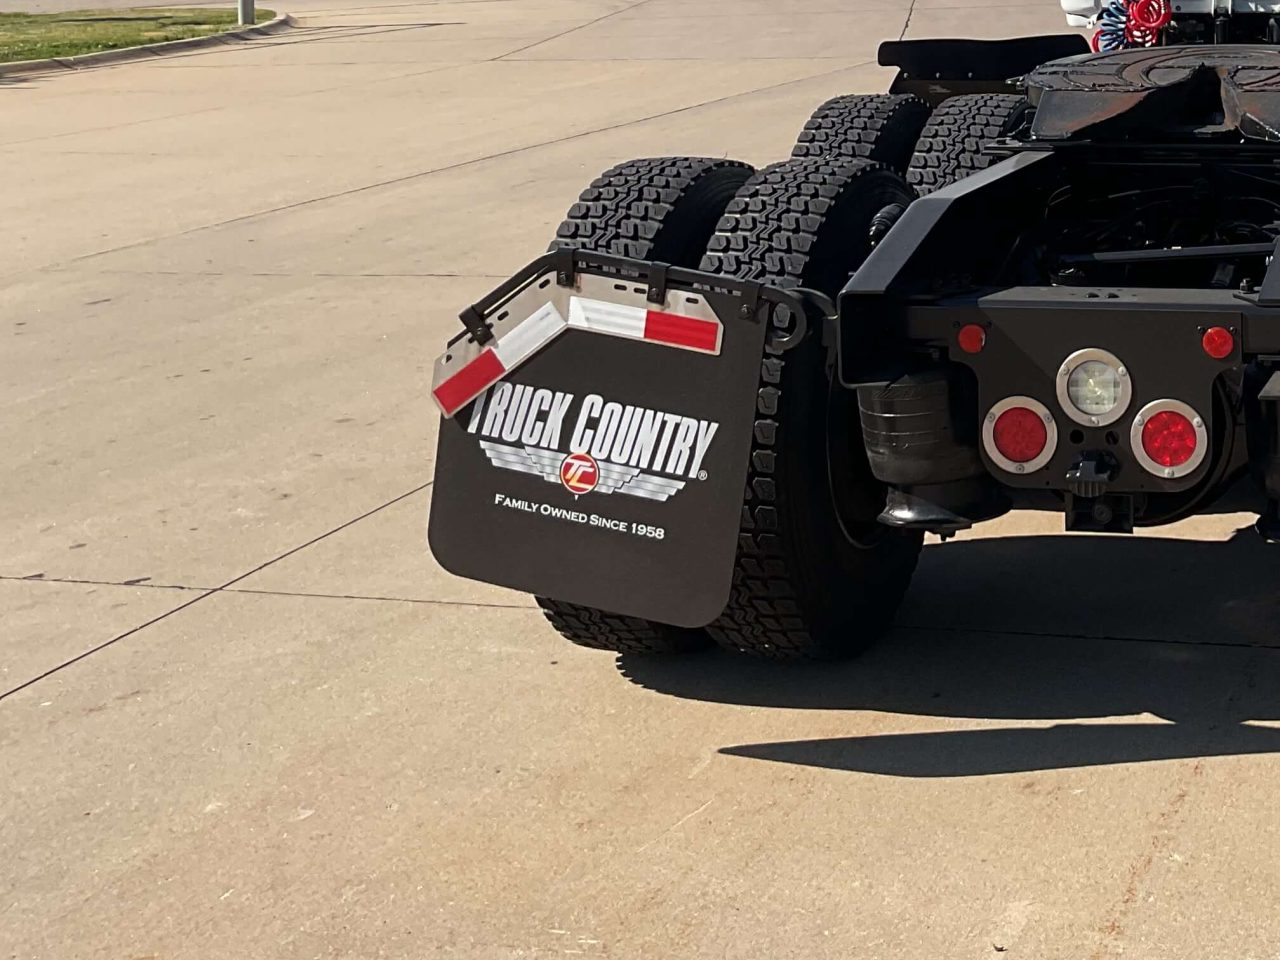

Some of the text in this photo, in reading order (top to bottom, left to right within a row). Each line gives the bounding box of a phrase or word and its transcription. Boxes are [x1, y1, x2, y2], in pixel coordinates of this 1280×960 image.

[569, 394, 720, 479] COUNTRY
[494, 493, 665, 540] FAMILY OWNED SINCE 1958
